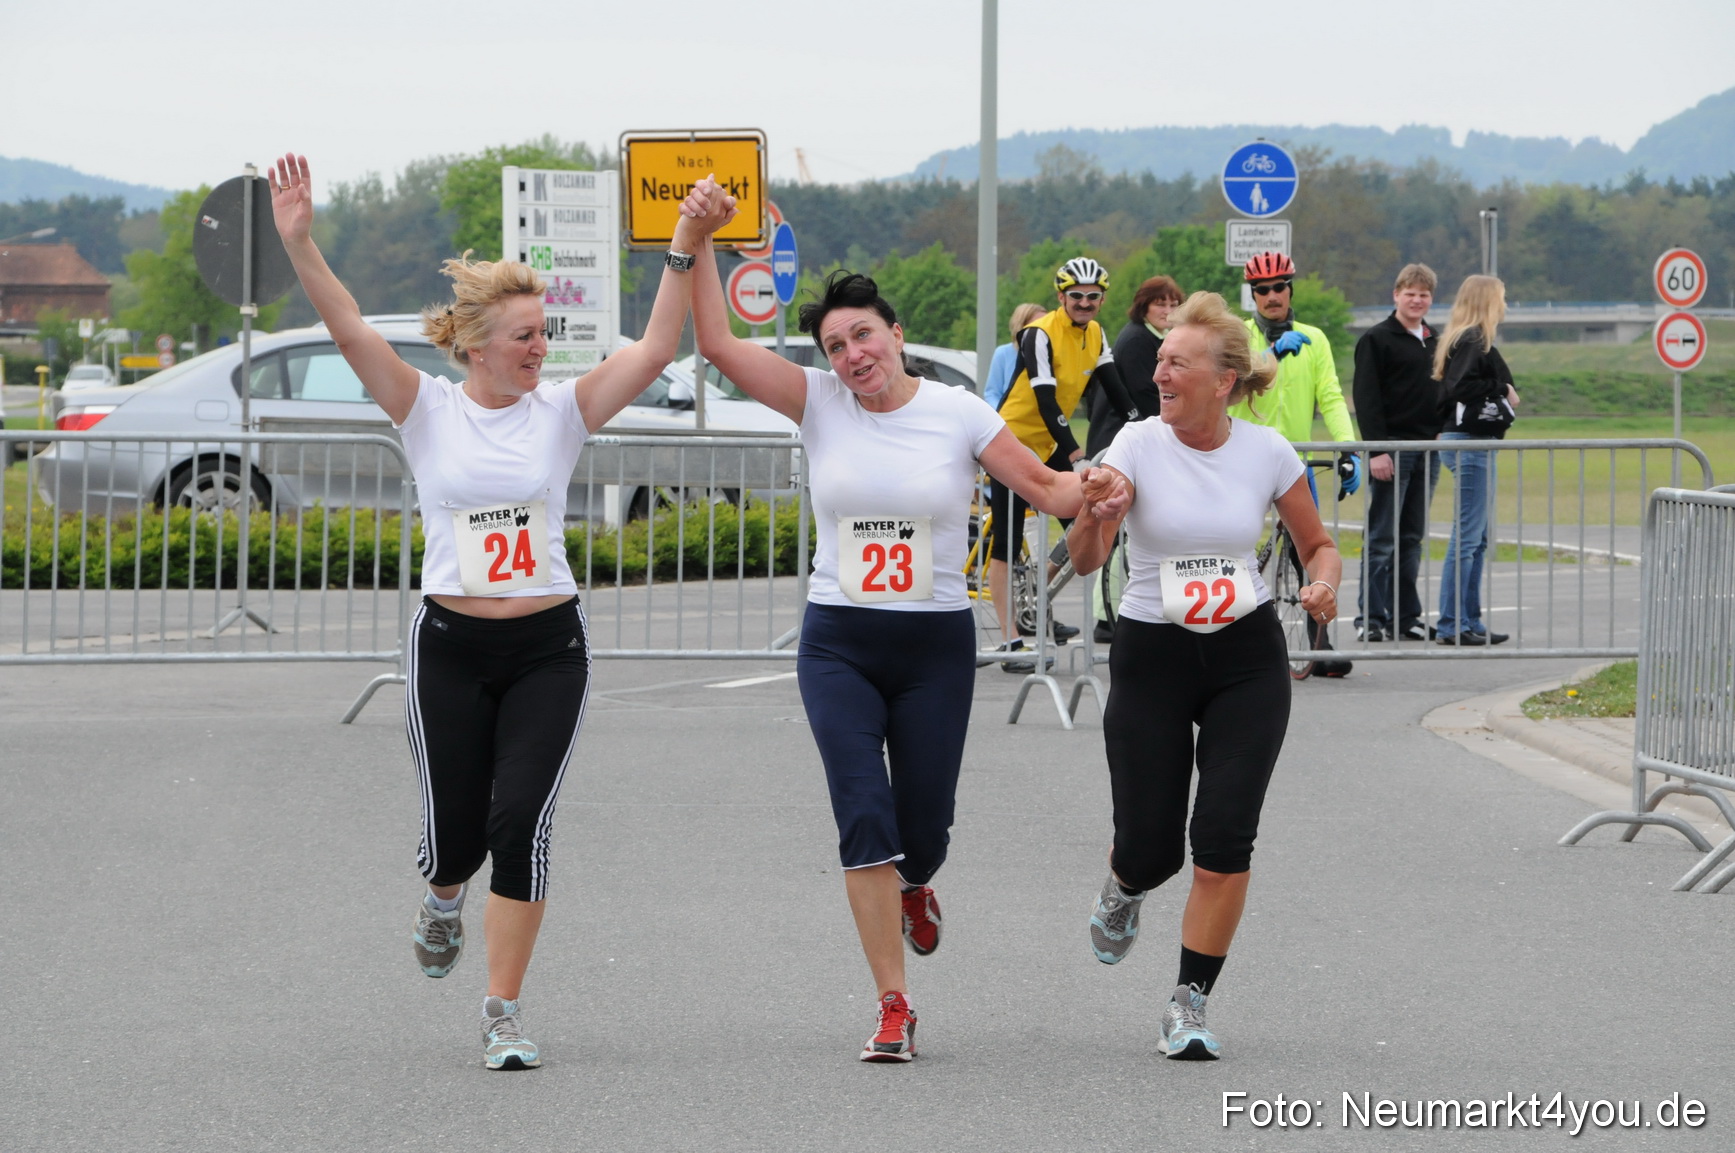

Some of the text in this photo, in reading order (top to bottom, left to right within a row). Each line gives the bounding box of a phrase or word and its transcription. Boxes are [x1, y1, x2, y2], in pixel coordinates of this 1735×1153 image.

[677, 155, 713, 168] Nach
[641, 176, 749, 201] Neukt
[1238, 226, 1279, 237] Landwirt-
[1234, 239, 1284, 248] schaftlicher
[530, 245, 552, 270] SHB
[1667, 266, 1695, 291] 60
[469, 509, 511, 524] MEYER
[470, 519, 513, 531] WERBUNG
[853, 520, 896, 531] MEYER
[853, 530, 897, 539] WERBUNG
[484, 528, 536, 583] 24
[862, 543, 913, 593] 23
[1176, 558, 1218, 570] MEYER
[1176, 568, 1219, 578] WERBUNG
[1184, 578, 1236, 624] 22
